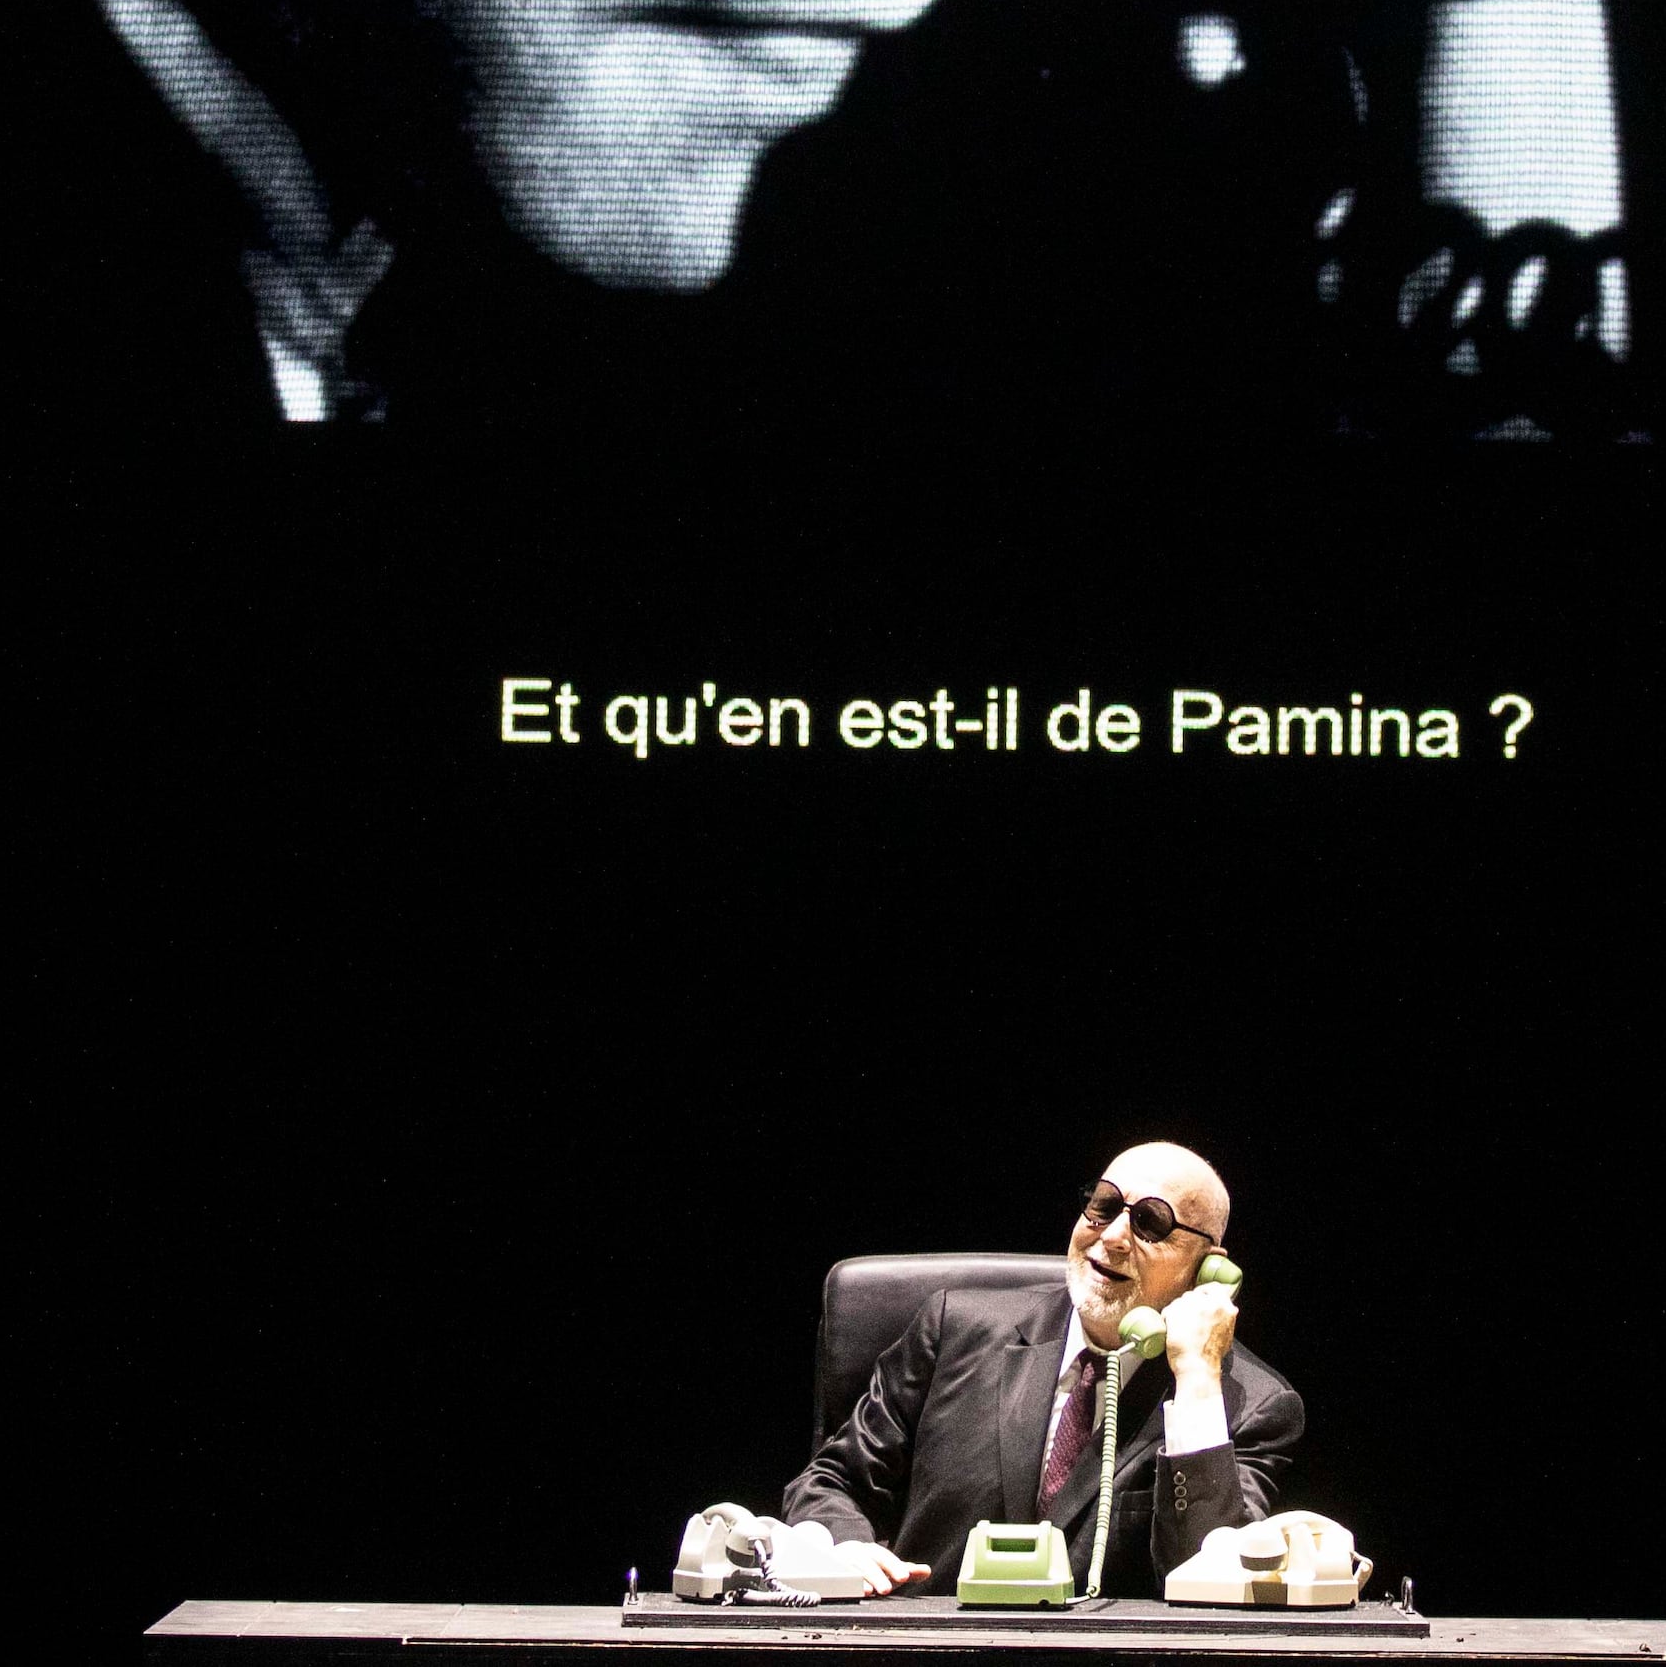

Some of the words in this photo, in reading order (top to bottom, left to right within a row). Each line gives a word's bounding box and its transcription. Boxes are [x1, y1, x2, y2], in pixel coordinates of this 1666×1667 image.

[501, 677, 581, 744] Et
[604, 682, 810, 759] qu'en
[839, 686, 1018, 751] est-il
[1046, 688, 1141, 753] de
[1172, 689, 1460, 759] Pamina
[1488, 693, 1534, 759] ?
